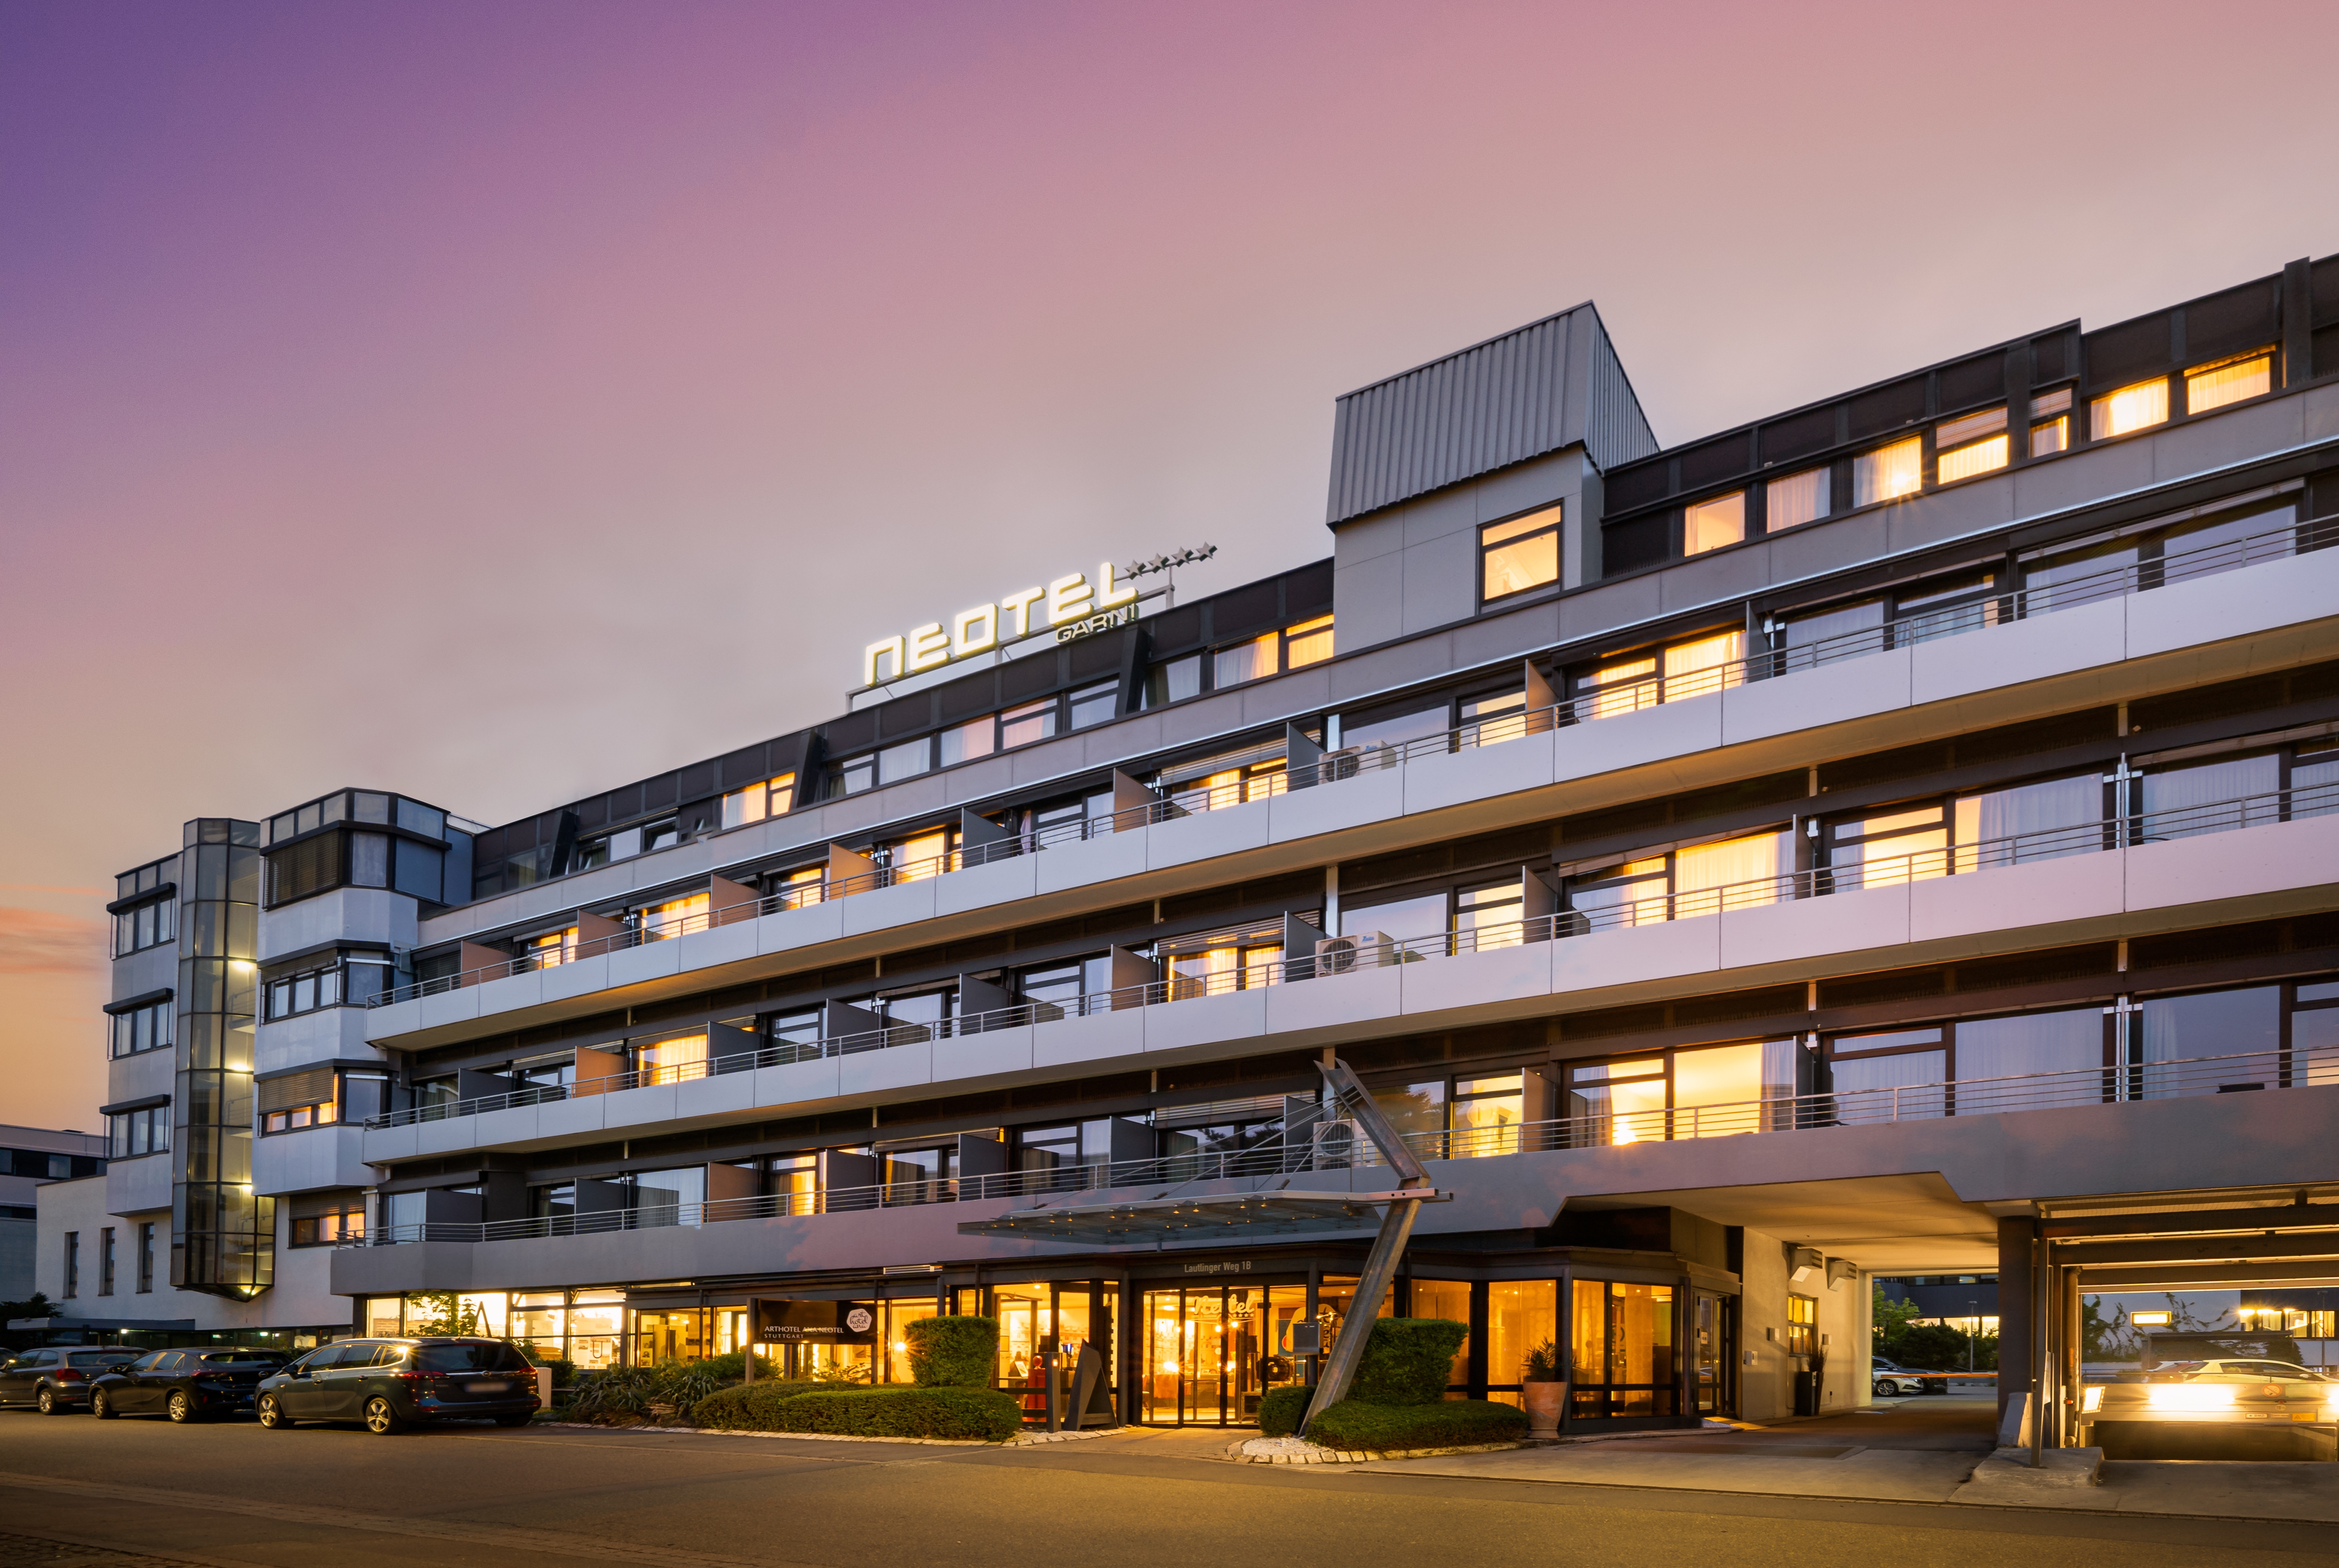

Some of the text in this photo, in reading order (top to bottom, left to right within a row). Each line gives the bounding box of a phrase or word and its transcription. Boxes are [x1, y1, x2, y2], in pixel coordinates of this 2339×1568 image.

[1055, 603, 1135, 643] GARNI
[1184, 1261, 1252, 1274] Lautlinger Weg 1B
[850, 1315, 868, 1325] hotel
